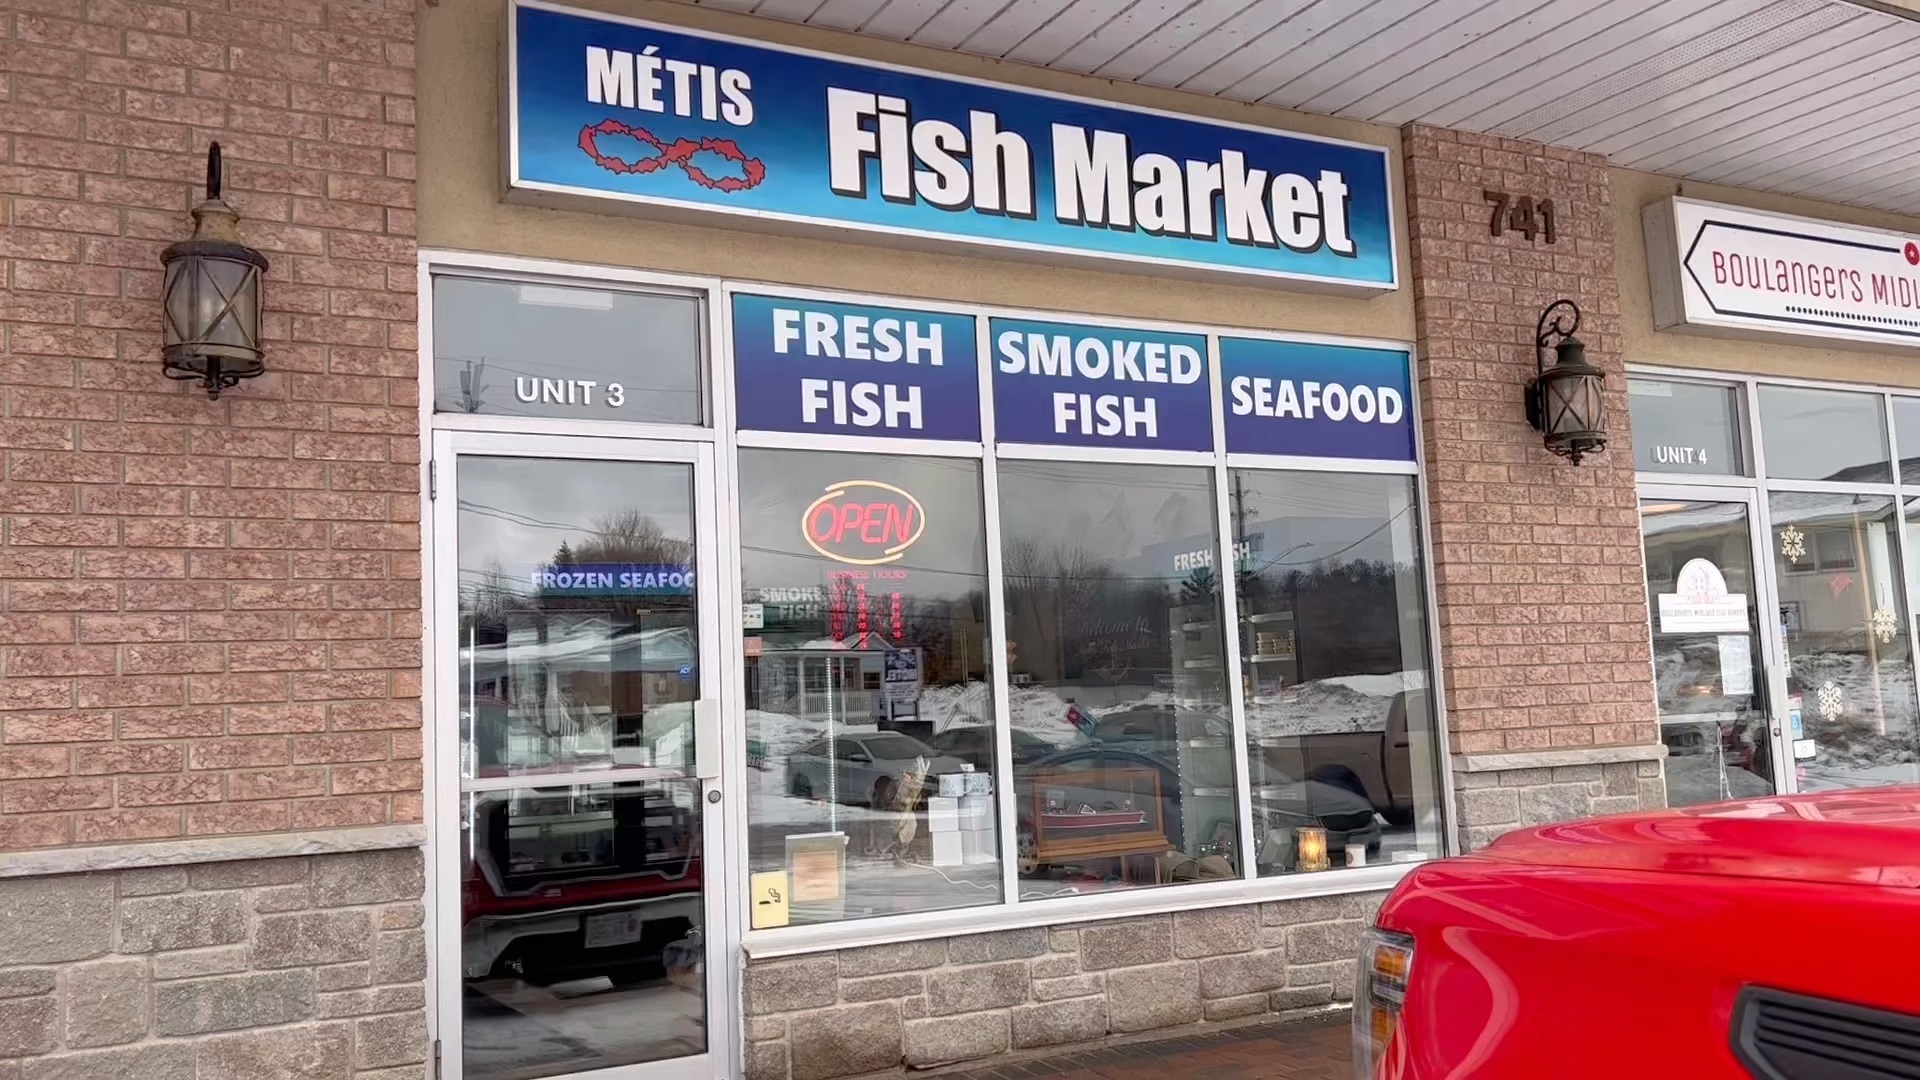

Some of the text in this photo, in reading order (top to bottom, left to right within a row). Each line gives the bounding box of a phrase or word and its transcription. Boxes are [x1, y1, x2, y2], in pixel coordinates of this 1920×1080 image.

[586, 45, 754, 127] MÉTIS
[827, 86, 1356, 258] Fish Market
[1483, 190, 1556, 244] 741
[773, 307, 944, 366] FRESH
[998, 329, 1202, 385] SMOKED
[516, 376, 625, 407] UNIT 3
[801, 378, 923, 430] FISH
[1053, 391, 1158, 438] FISH
[1230, 375, 1404, 425] SEAFOOD
[1656, 445, 1708, 465] UNIT 4
[809, 501, 914, 544] OPEN
[1174, 541, 1251, 572] FRESH SH
[531, 572, 614, 589] FROZEN
[759, 587, 822, 602] SMOKE
[779, 604, 819, 619] FISH
